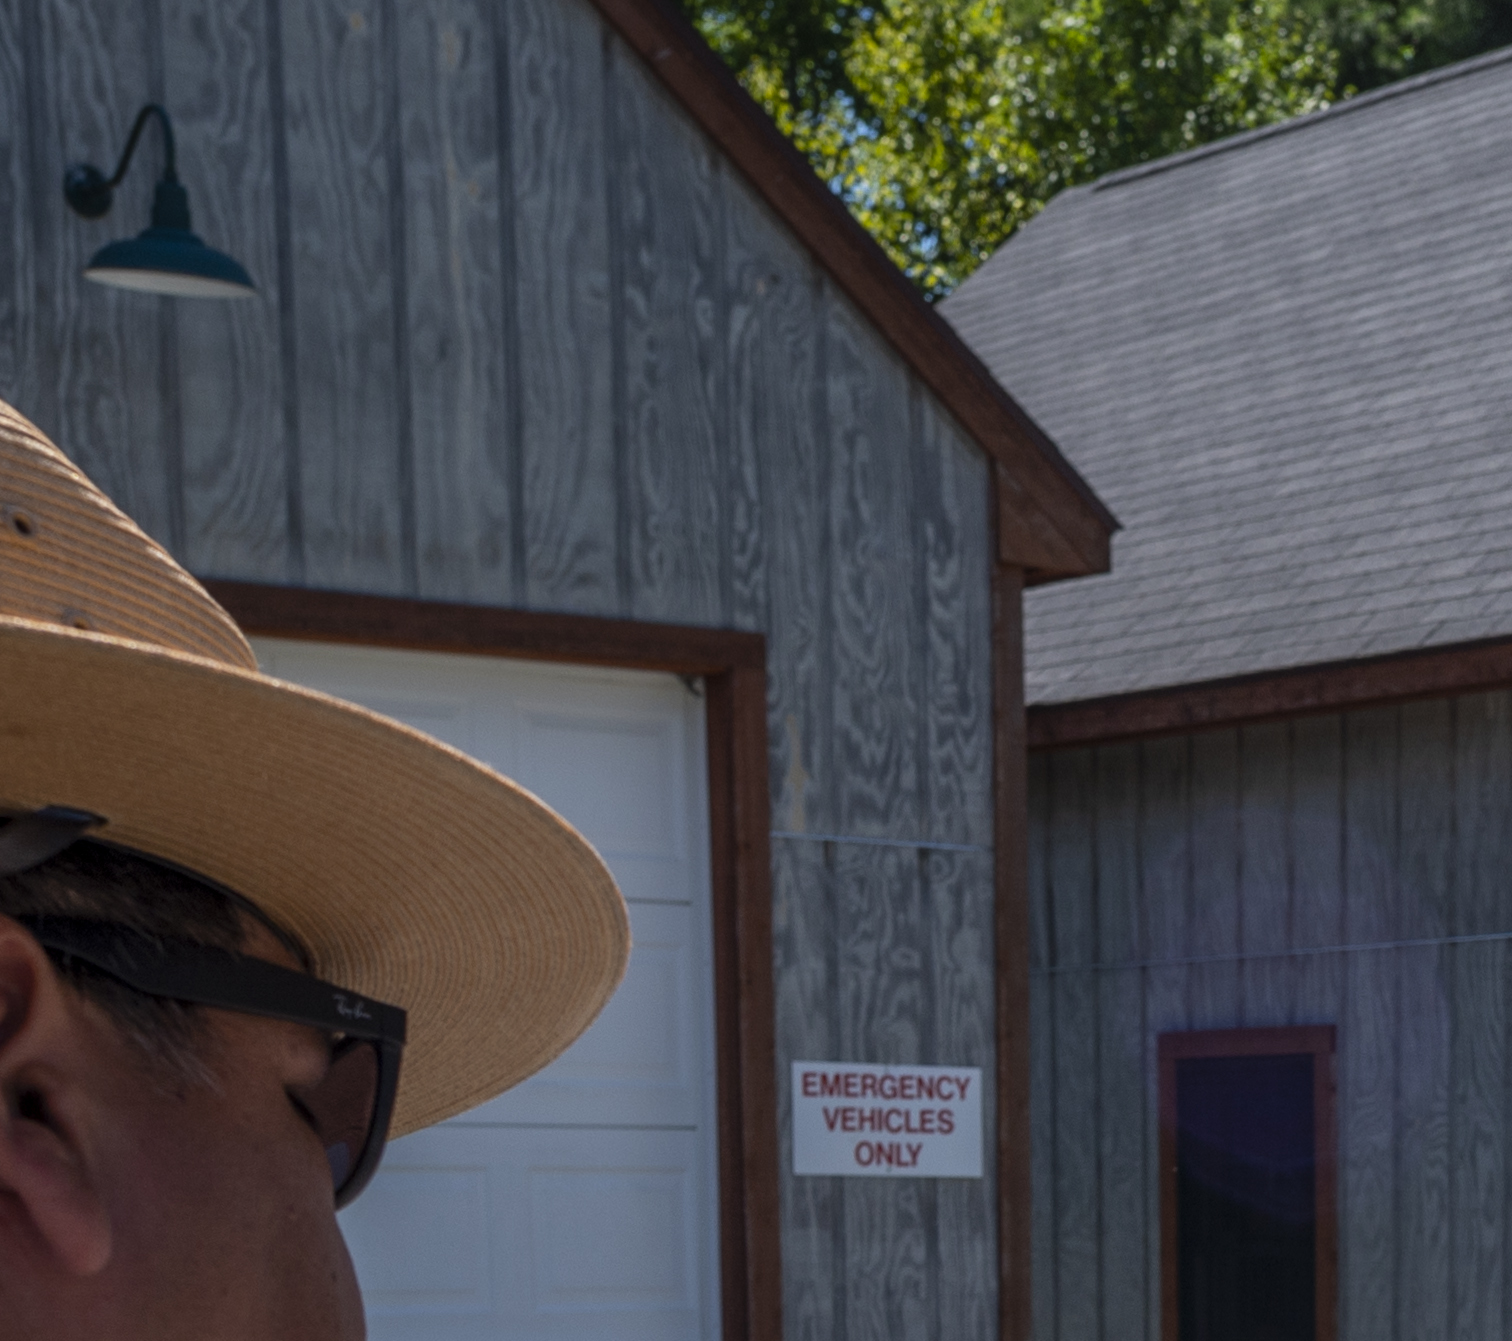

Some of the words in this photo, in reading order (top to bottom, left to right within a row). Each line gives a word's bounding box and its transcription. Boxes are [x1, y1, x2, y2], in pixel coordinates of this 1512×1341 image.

[801, 1071, 971, 1101] EMERGENCY
[821, 1106, 955, 1135] VEHICLES
[854, 1140, 923, 1168] ONLY
